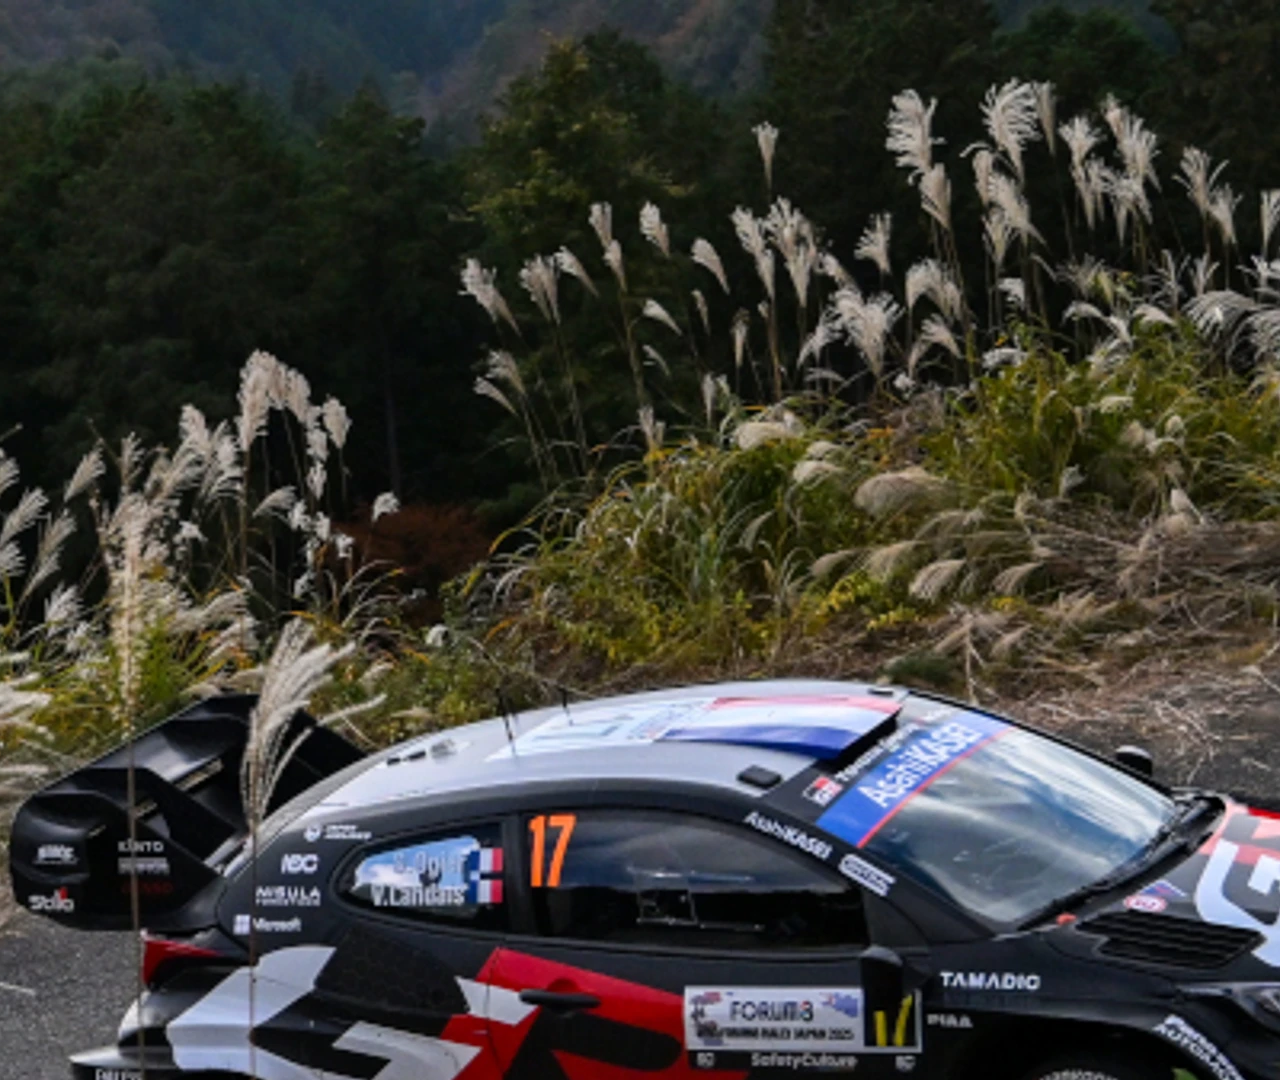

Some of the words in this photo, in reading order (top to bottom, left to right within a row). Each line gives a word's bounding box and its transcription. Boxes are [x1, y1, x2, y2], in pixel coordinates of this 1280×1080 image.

[117, 841, 165, 852] KNTO
[529, 813, 576, 888] 17
[940, 971, 1040, 990] TAMADIC
